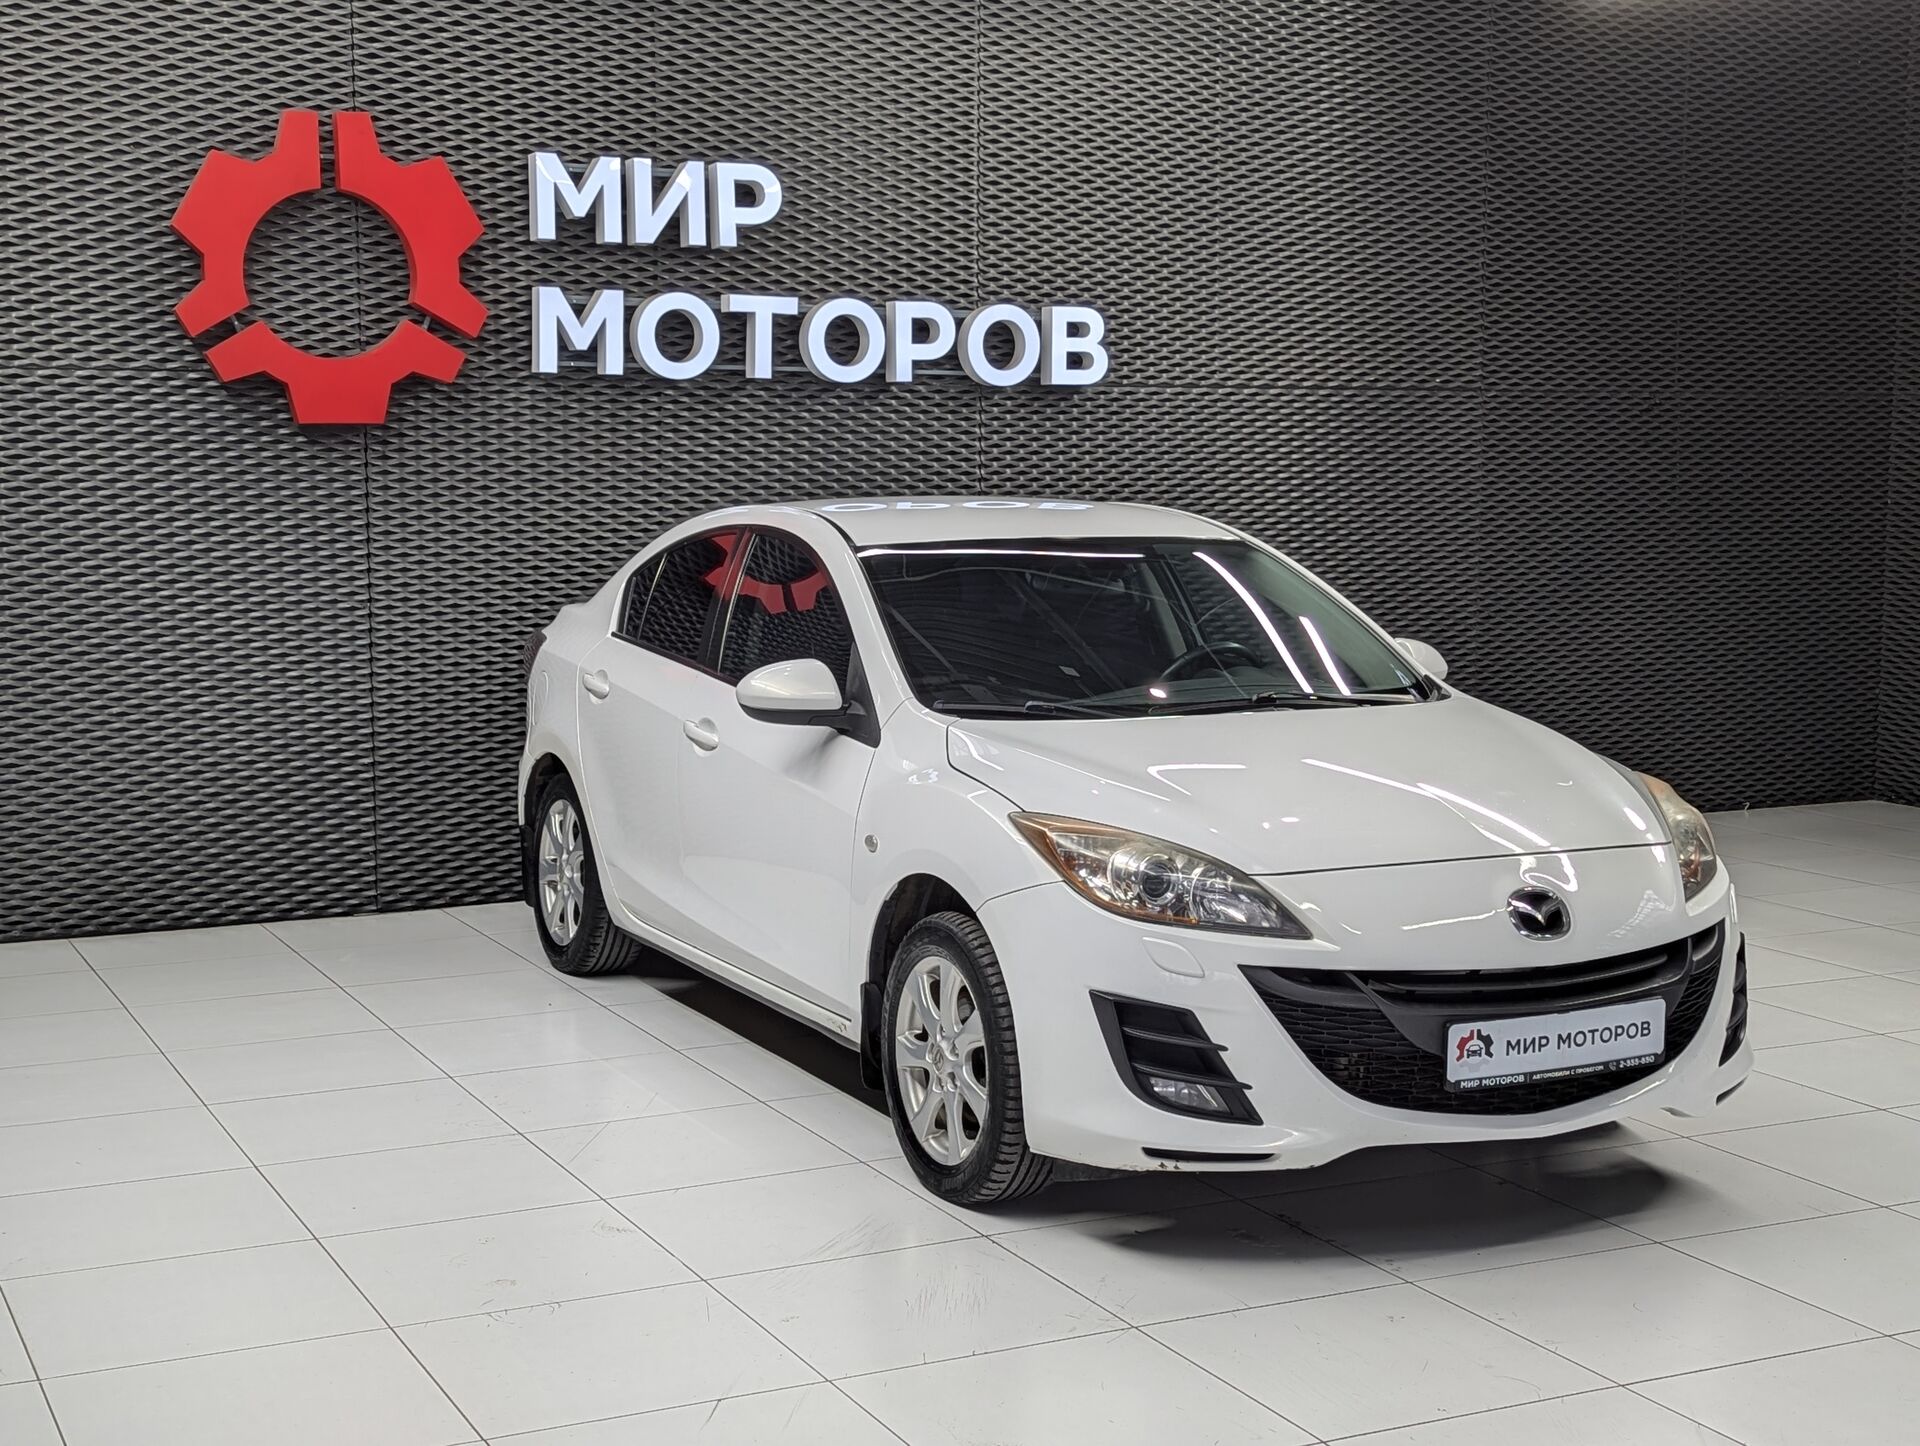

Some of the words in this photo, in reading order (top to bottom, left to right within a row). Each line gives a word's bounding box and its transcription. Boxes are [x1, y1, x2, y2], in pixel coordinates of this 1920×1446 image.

[528, 151, 783, 249] МИР
[531, 286, 1109, 387] МОТОРОВ
[1505, 1035, 1550, 1057] МИР
[1557, 1020, 1651, 1050] МОТОРОВ
[1460, 1079, 1480, 1089] МИР
[1481, 1074, 1525, 1087] МОТОРОВ
[1532, 1070, 1570, 1080] АВТОМОБИЛИ
[1575, 1065, 1604, 1074] ПРОБЕГОМ
